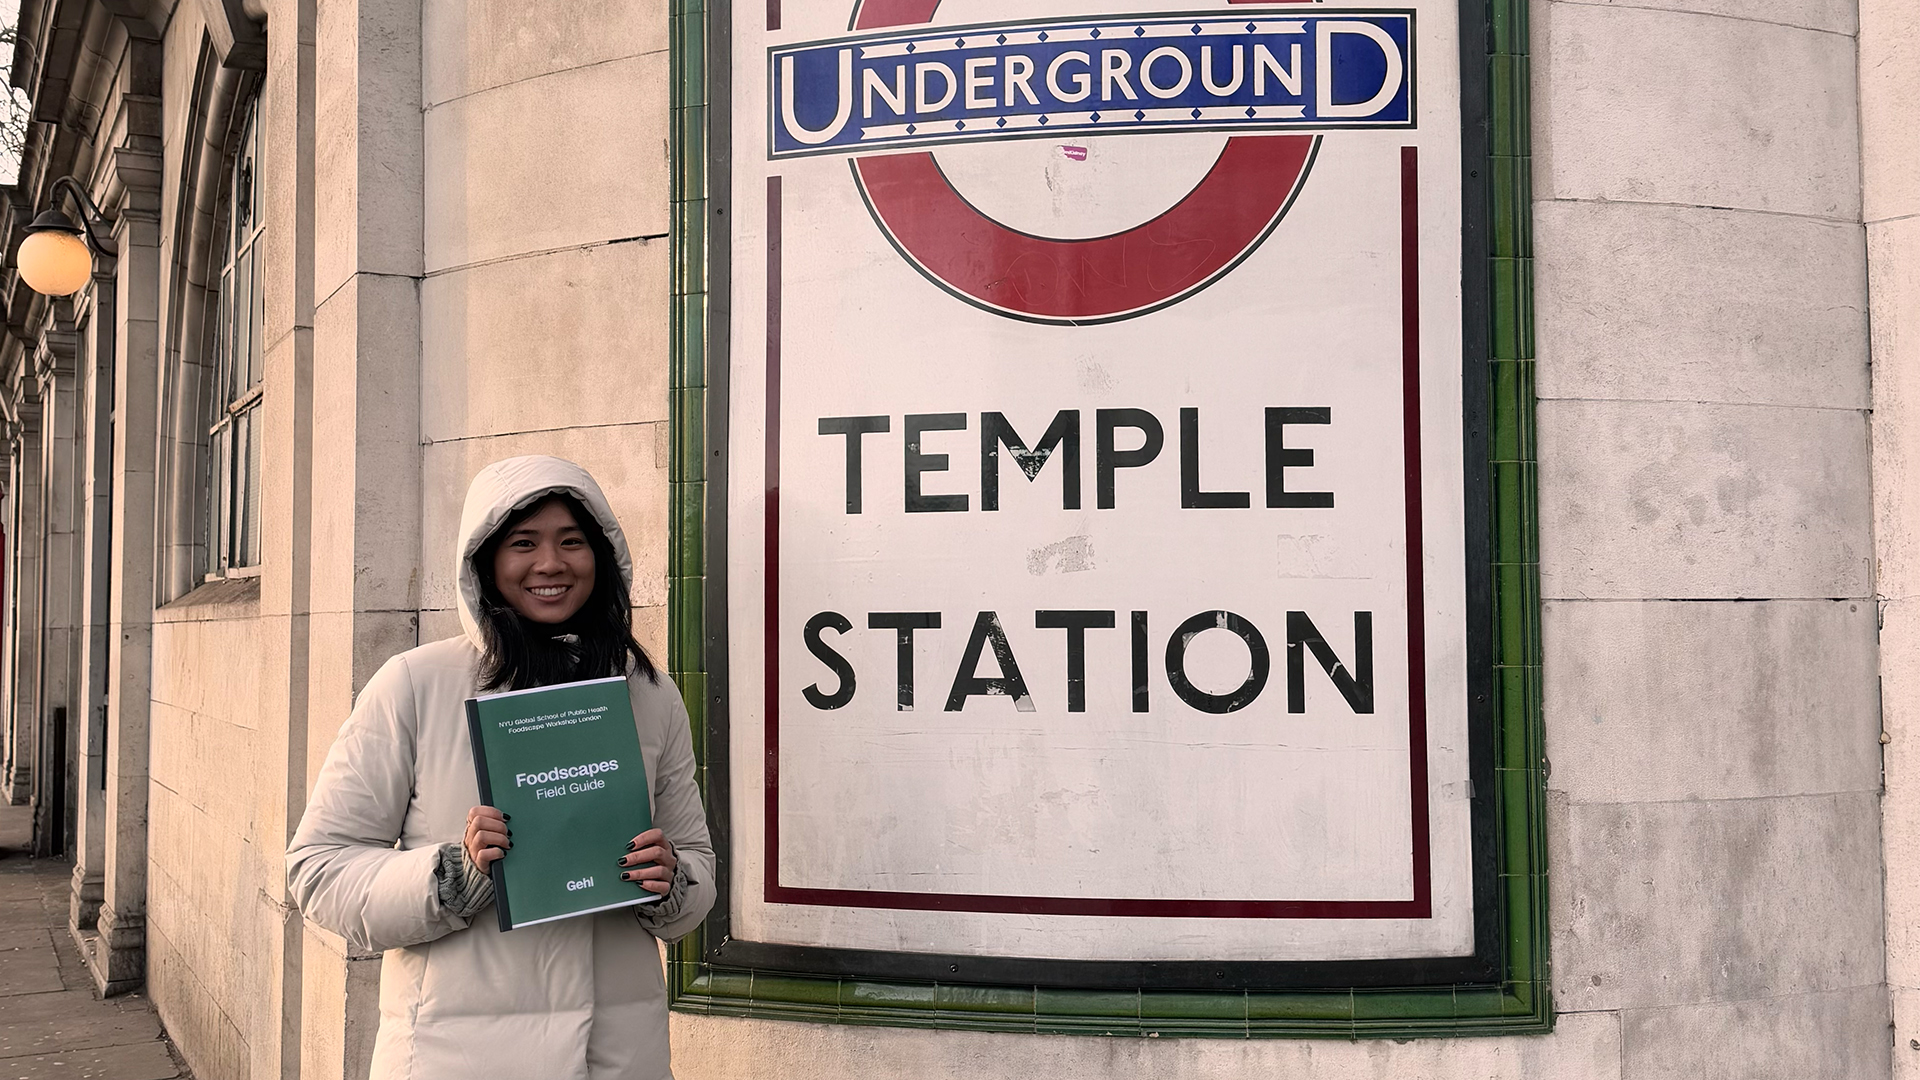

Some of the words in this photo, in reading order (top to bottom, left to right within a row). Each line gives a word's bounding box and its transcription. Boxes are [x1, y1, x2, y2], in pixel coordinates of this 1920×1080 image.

[780, 20, 1403, 146] UNDERGROUND
[817, 406, 1335, 515] TEMPLE
[801, 609, 1375, 715] STATION
[508, 724, 545, 734] Foodscape
[545, 719, 578, 728] Workshop
[578, 714, 602, 723] London
[514, 716, 536, 726] Global
[536, 713, 559, 722] School
[567, 709, 587, 717] Public
[587, 705, 609, 714] Health
[515, 759, 619, 788] Foodscapes
[535, 784, 567, 800] Field
[569, 778, 605, 794] Guide
[566, 876, 594, 892] Gehl
